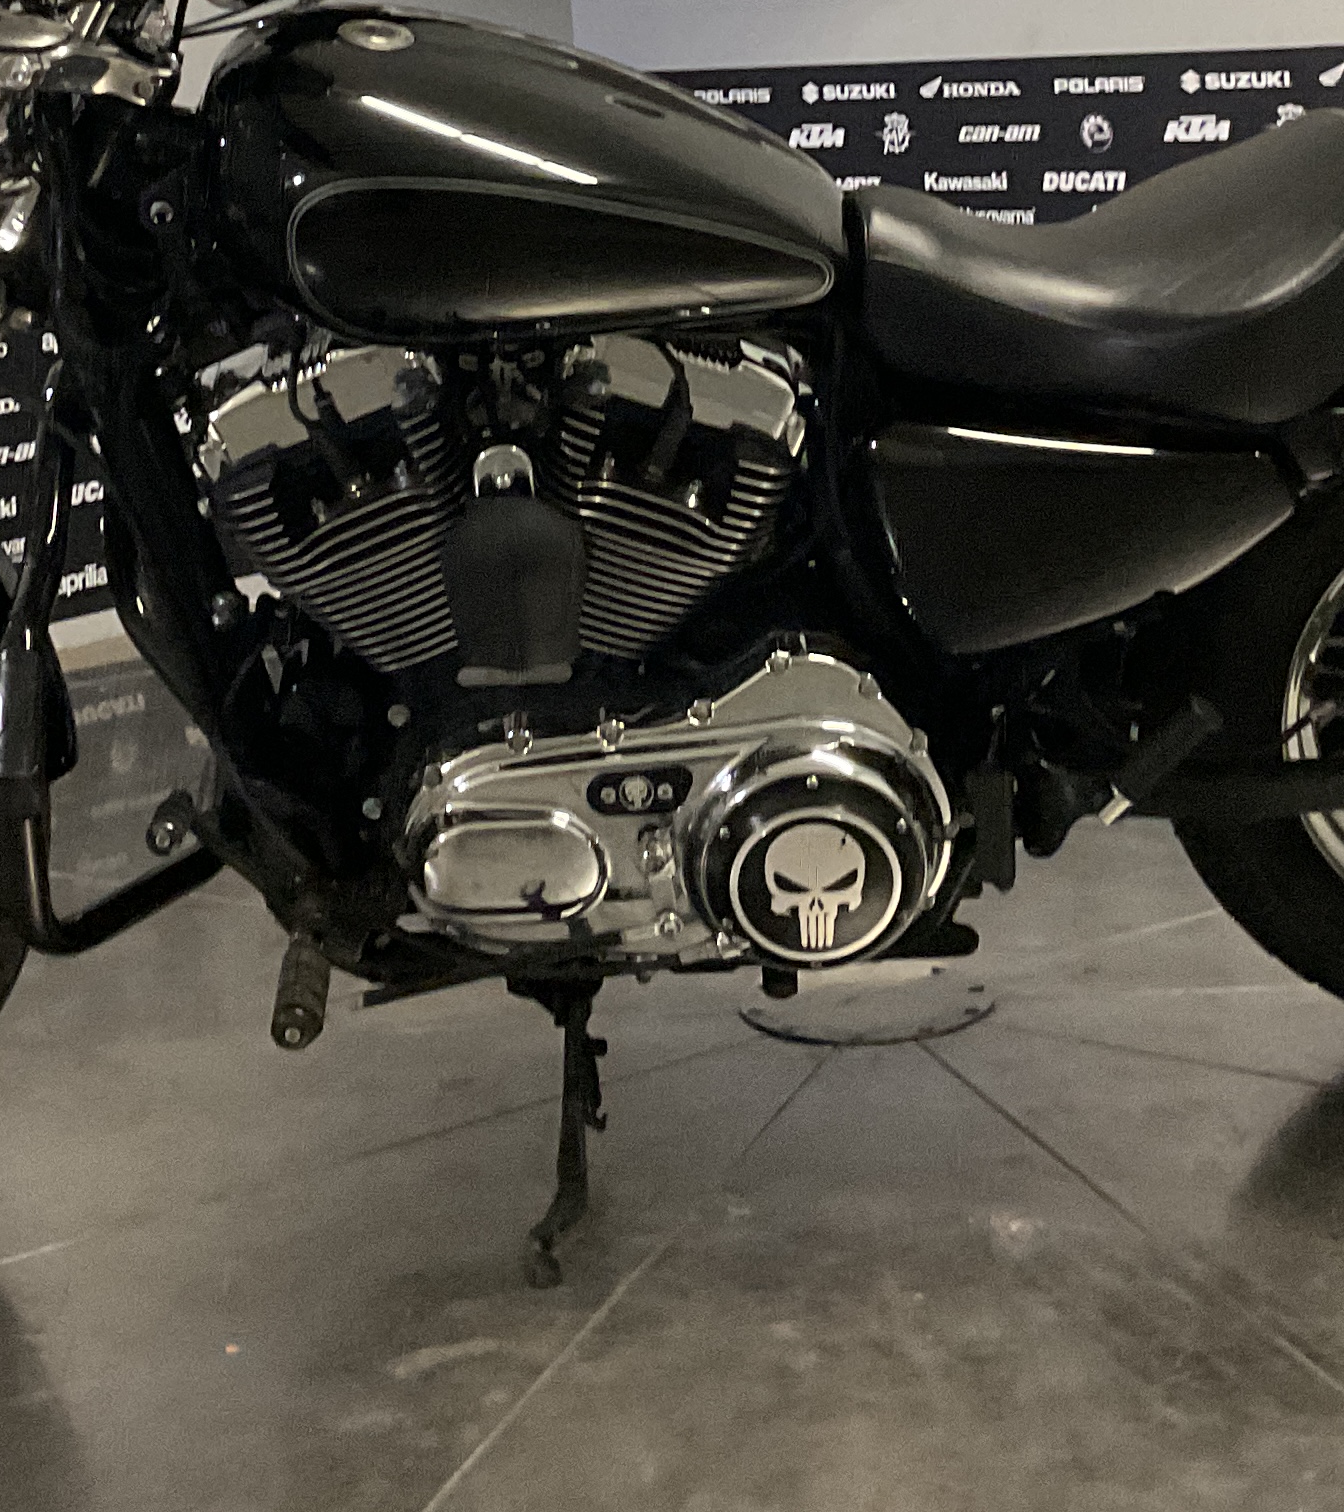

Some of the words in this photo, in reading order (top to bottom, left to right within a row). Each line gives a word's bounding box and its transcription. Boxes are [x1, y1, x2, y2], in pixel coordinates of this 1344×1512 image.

[943, 81, 1020, 98] HONDA
[1054, 76, 1143, 94] POLARIS
[1205, 71, 1290, 90] SUZUKI
[823, 83, 895, 100] SUZUKI
[789, 123, 844, 149] KTM
[959, 125, 1040, 142] can-am
[1164, 115, 1230, 142] KTM
[924, 171, 1007, 191] Kawasaki
[1043, 171, 1126, 191] DUCATI
